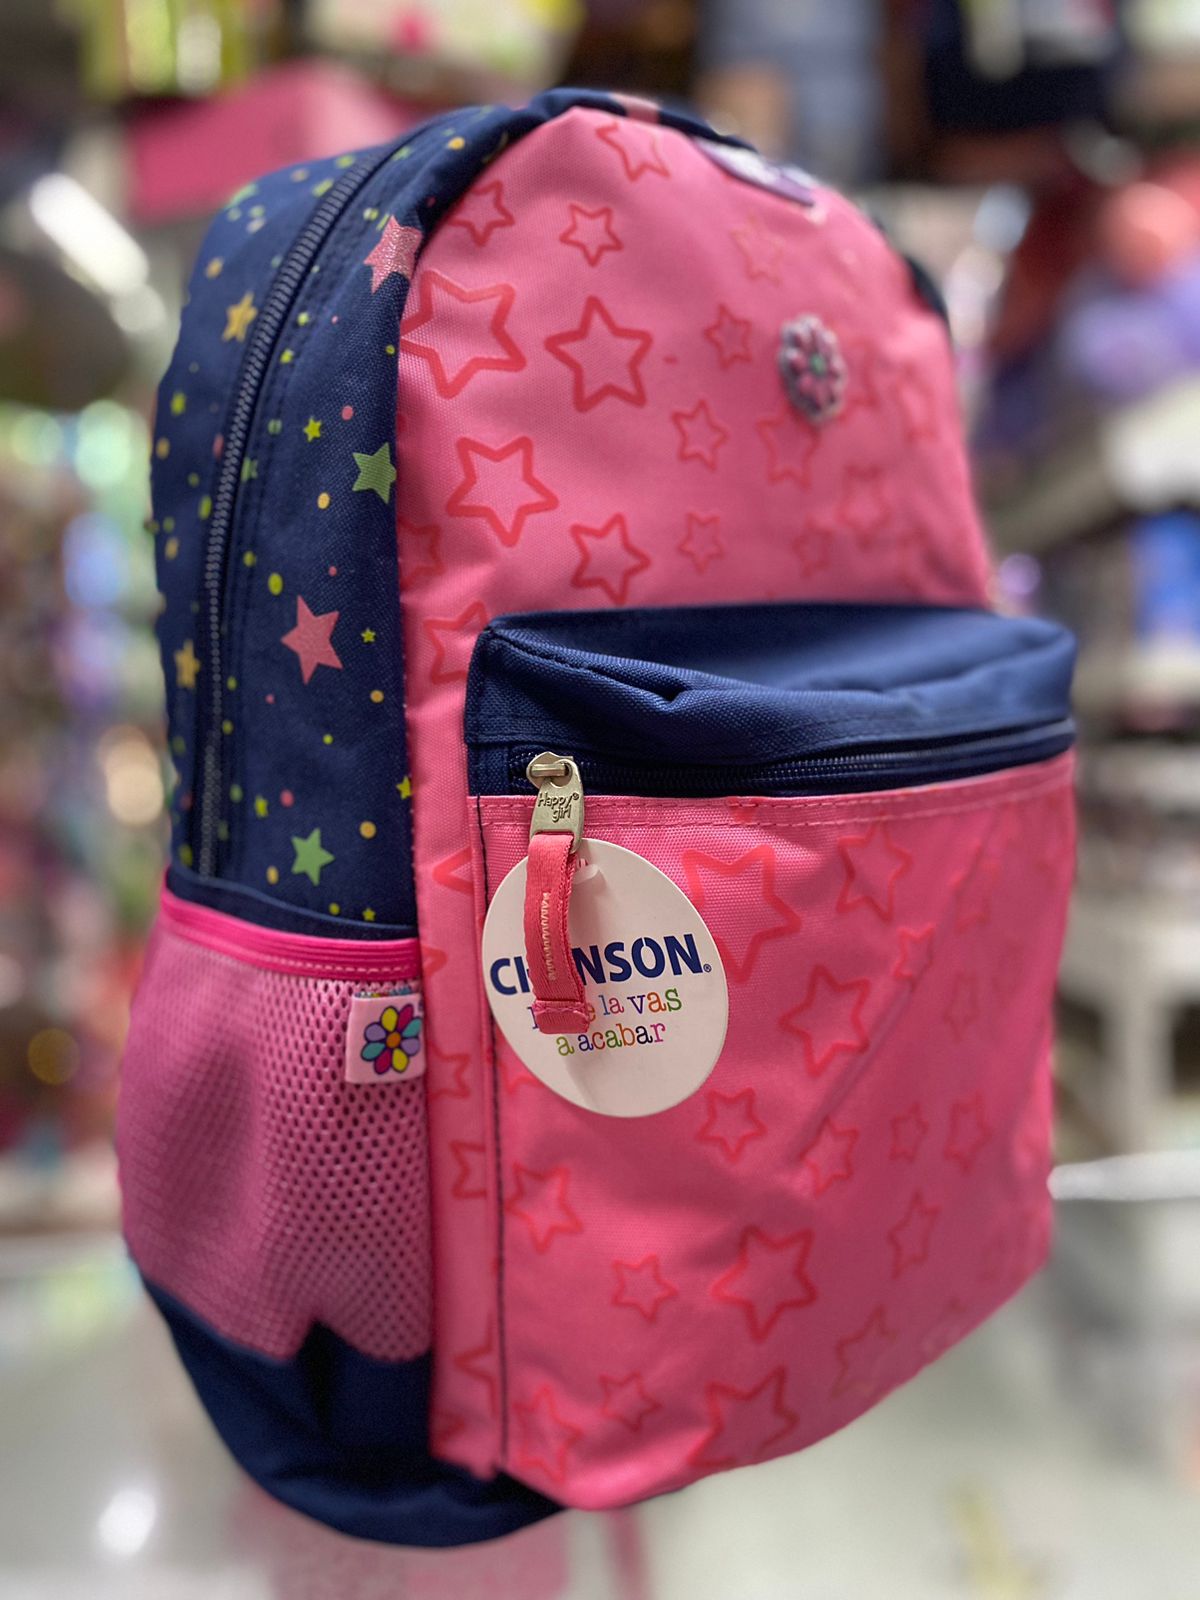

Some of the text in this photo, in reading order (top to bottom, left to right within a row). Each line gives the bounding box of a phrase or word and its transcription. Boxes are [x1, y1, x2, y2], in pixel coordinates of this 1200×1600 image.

[552, 805, 572, 823] girl
[598, 994, 625, 1015] la
[627, 987, 683, 1014] vas
[556, 1022, 667, 1057] a acabar
